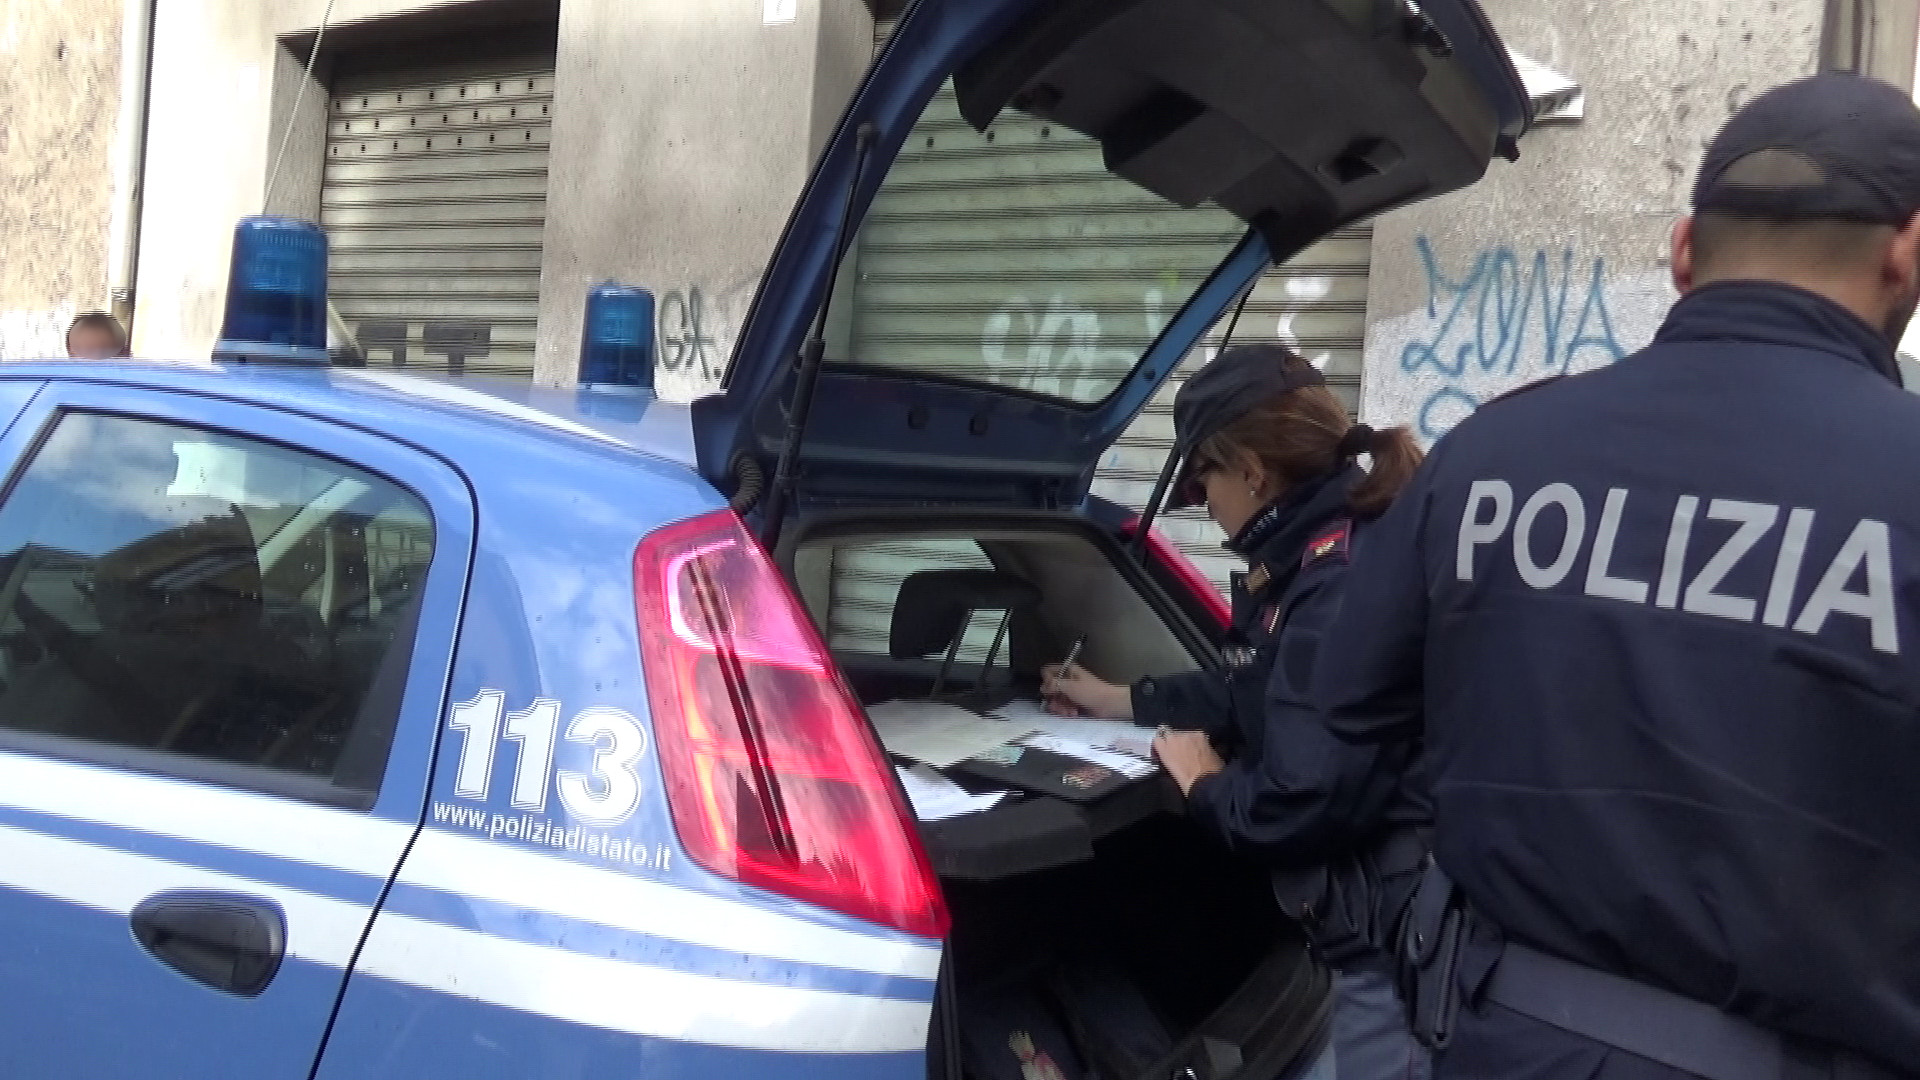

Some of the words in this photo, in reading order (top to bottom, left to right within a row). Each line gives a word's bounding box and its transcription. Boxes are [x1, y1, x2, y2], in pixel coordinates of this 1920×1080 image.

[1400, 235, 1626, 377] ZONA
[1456, 479, 1900, 655] POLIZIA
[449, 687, 648, 828] 113
[433, 800, 672, 871] www.poliziadistato.it
